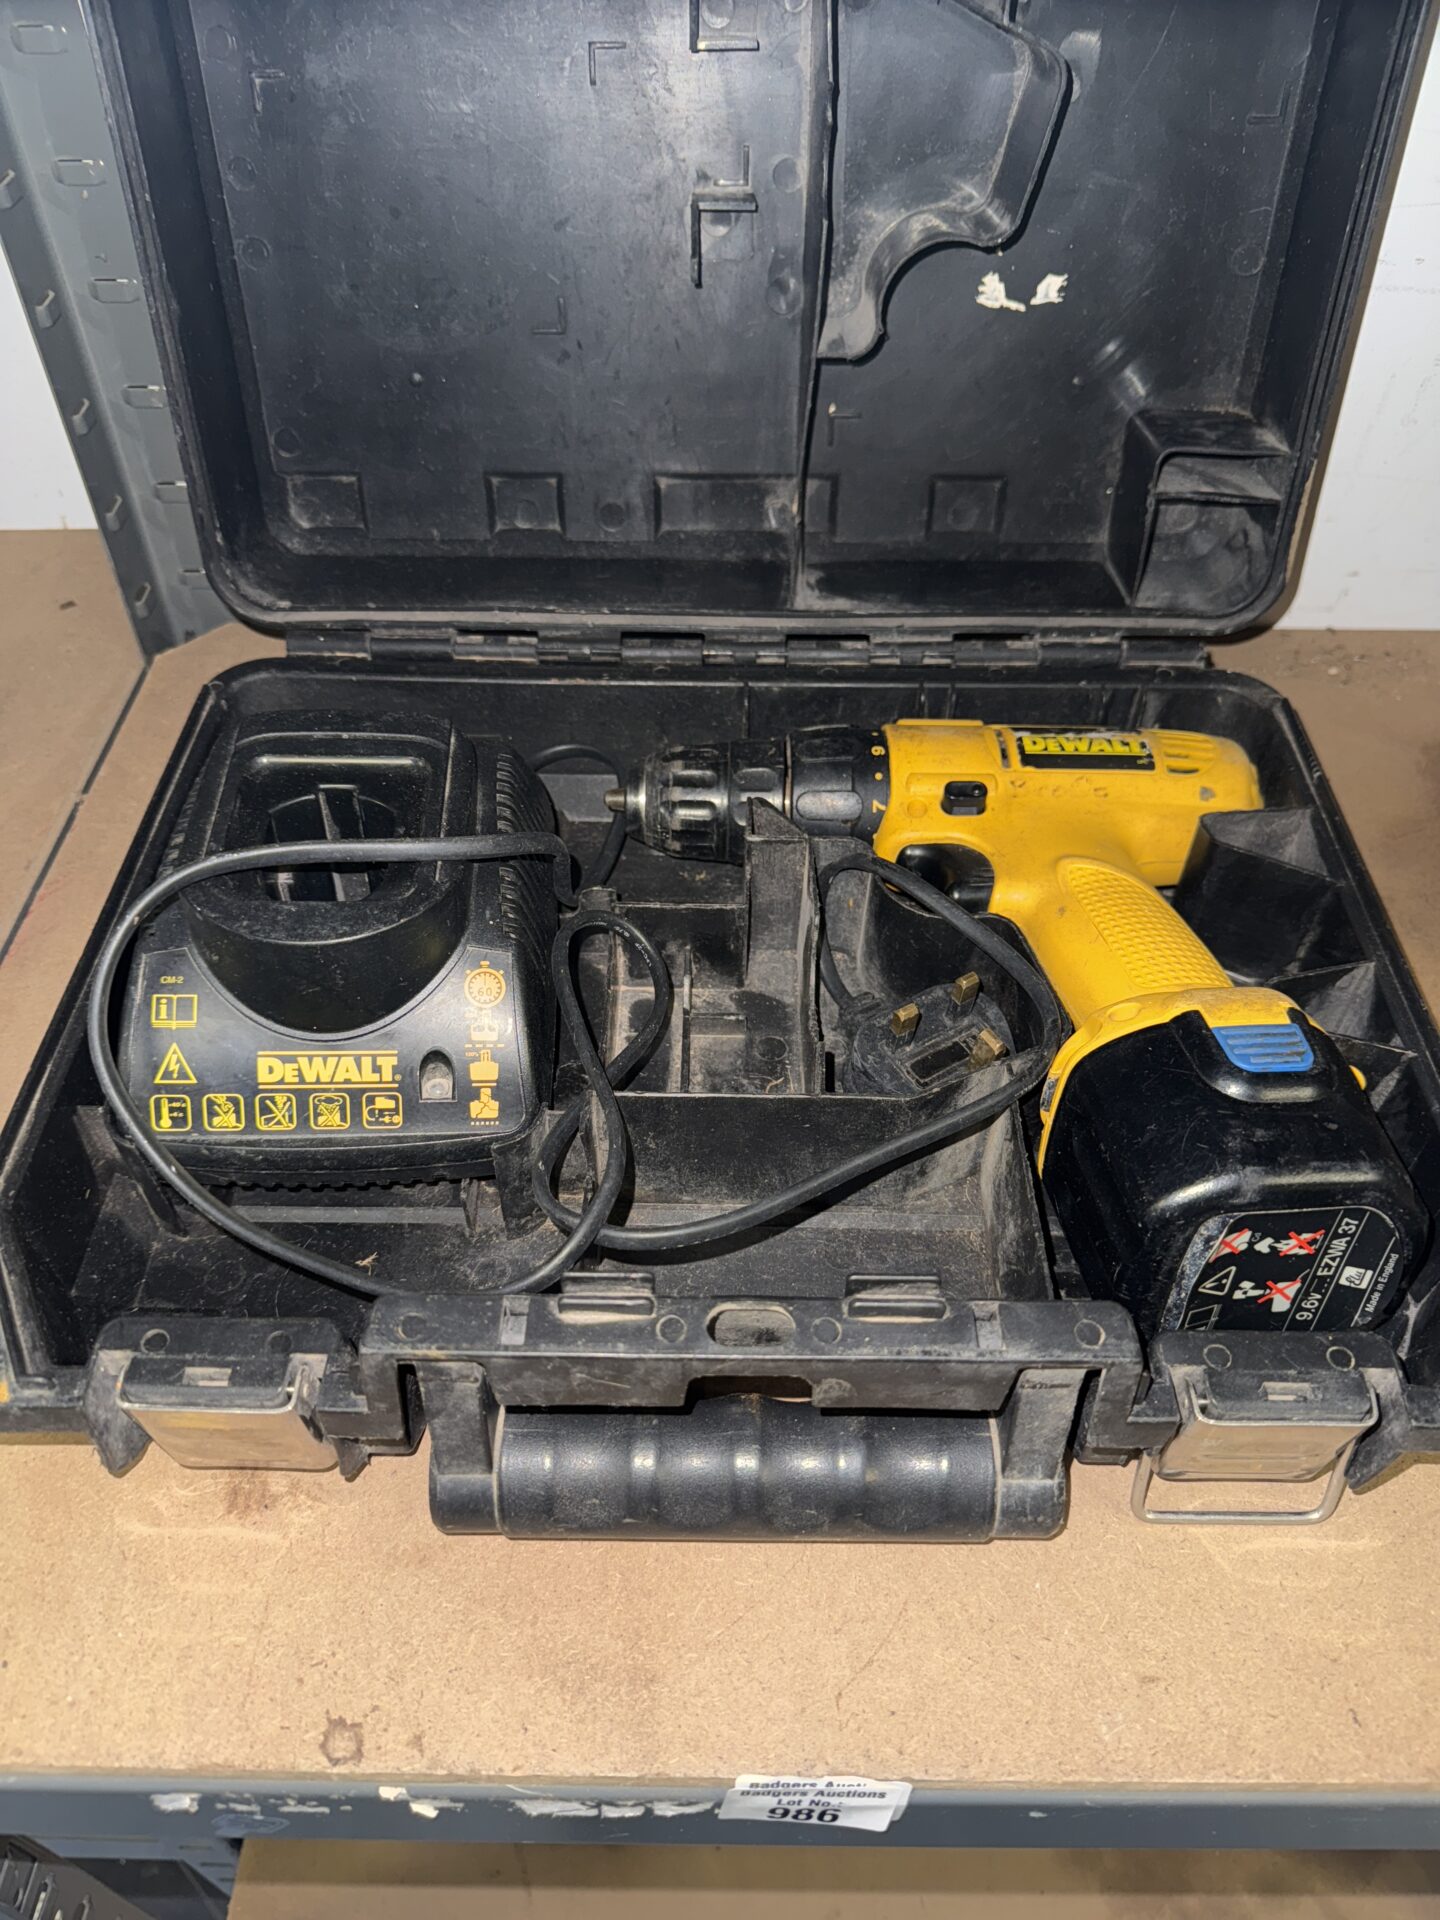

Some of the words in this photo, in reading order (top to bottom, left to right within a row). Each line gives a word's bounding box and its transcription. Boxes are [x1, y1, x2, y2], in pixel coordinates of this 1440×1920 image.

[1022, 736, 1144, 753] DEWALT
[872, 799, 887, 813] 7
[160, 976, 184, 984] CM-2
[478, 987, 493, 997] 60
[257, 1056, 398, 1084] DEWALT
[1316, 1236, 1351, 1276] EZWA
[1338, 1217, 1359, 1234] 37
[1377, 1252, 1400, 1283] England
[1374, 1283, 1386, 1291] in
[1364, 1291, 1381, 1313] Made
[814, 1790, 887, 1799] Auctions
[777, 1798, 801, 1807] Lot
[766, 1807, 842, 1823] 986
